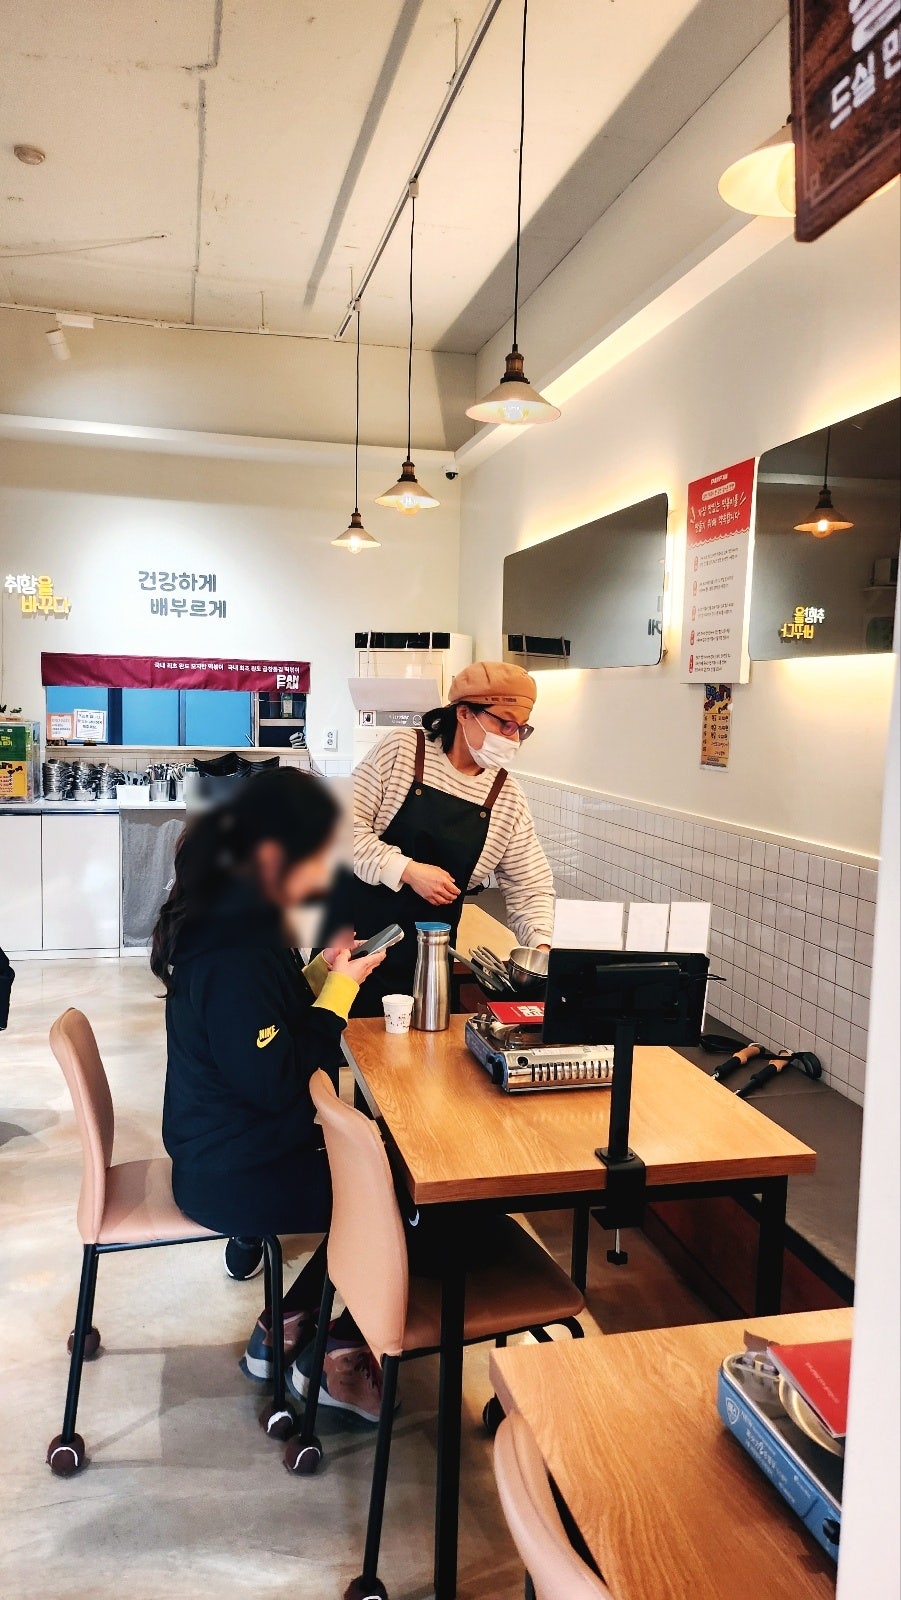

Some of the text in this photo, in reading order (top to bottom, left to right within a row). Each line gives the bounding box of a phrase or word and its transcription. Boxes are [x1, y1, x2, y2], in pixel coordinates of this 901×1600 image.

[830, 51, 875, 130] 드실
[5, 574, 53, 596] 취향을
[138, 570, 217, 592] 건강하게
[21, 595, 71, 614] 바꾸다
[150, 597, 227, 619] 배부르게
[276, 674, 300, 682] PAN
[259, 1025, 276, 1040] NIKE
